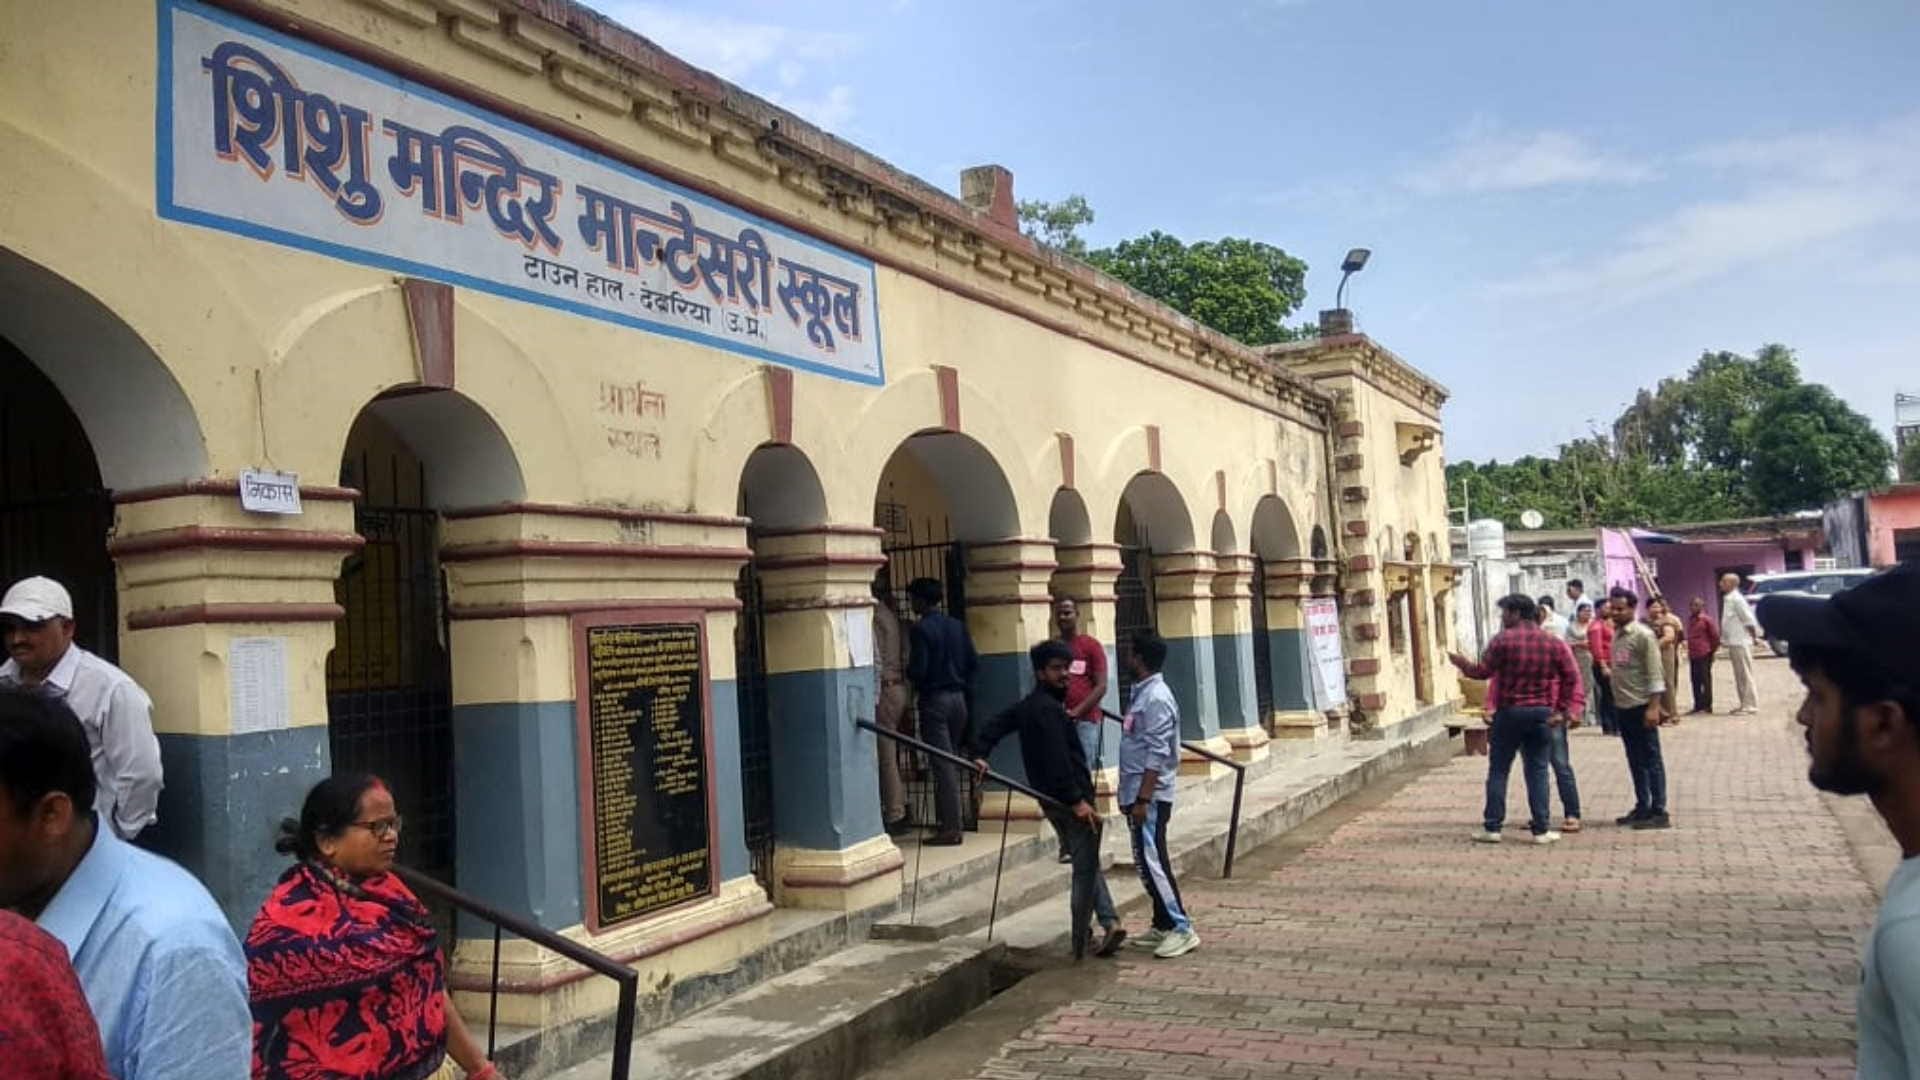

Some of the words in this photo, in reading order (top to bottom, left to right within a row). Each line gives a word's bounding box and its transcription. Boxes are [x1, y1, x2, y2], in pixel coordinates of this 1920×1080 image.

[201, 41, 384, 225] शिशु
[382, 118, 563, 255] मन्दिर
[575, 184, 776, 315] मान्टेसरी
[777, 256, 863, 352] स्कूल
[523, 254, 578, 288] टाउन
[584, 272, 624, 302] हाल
